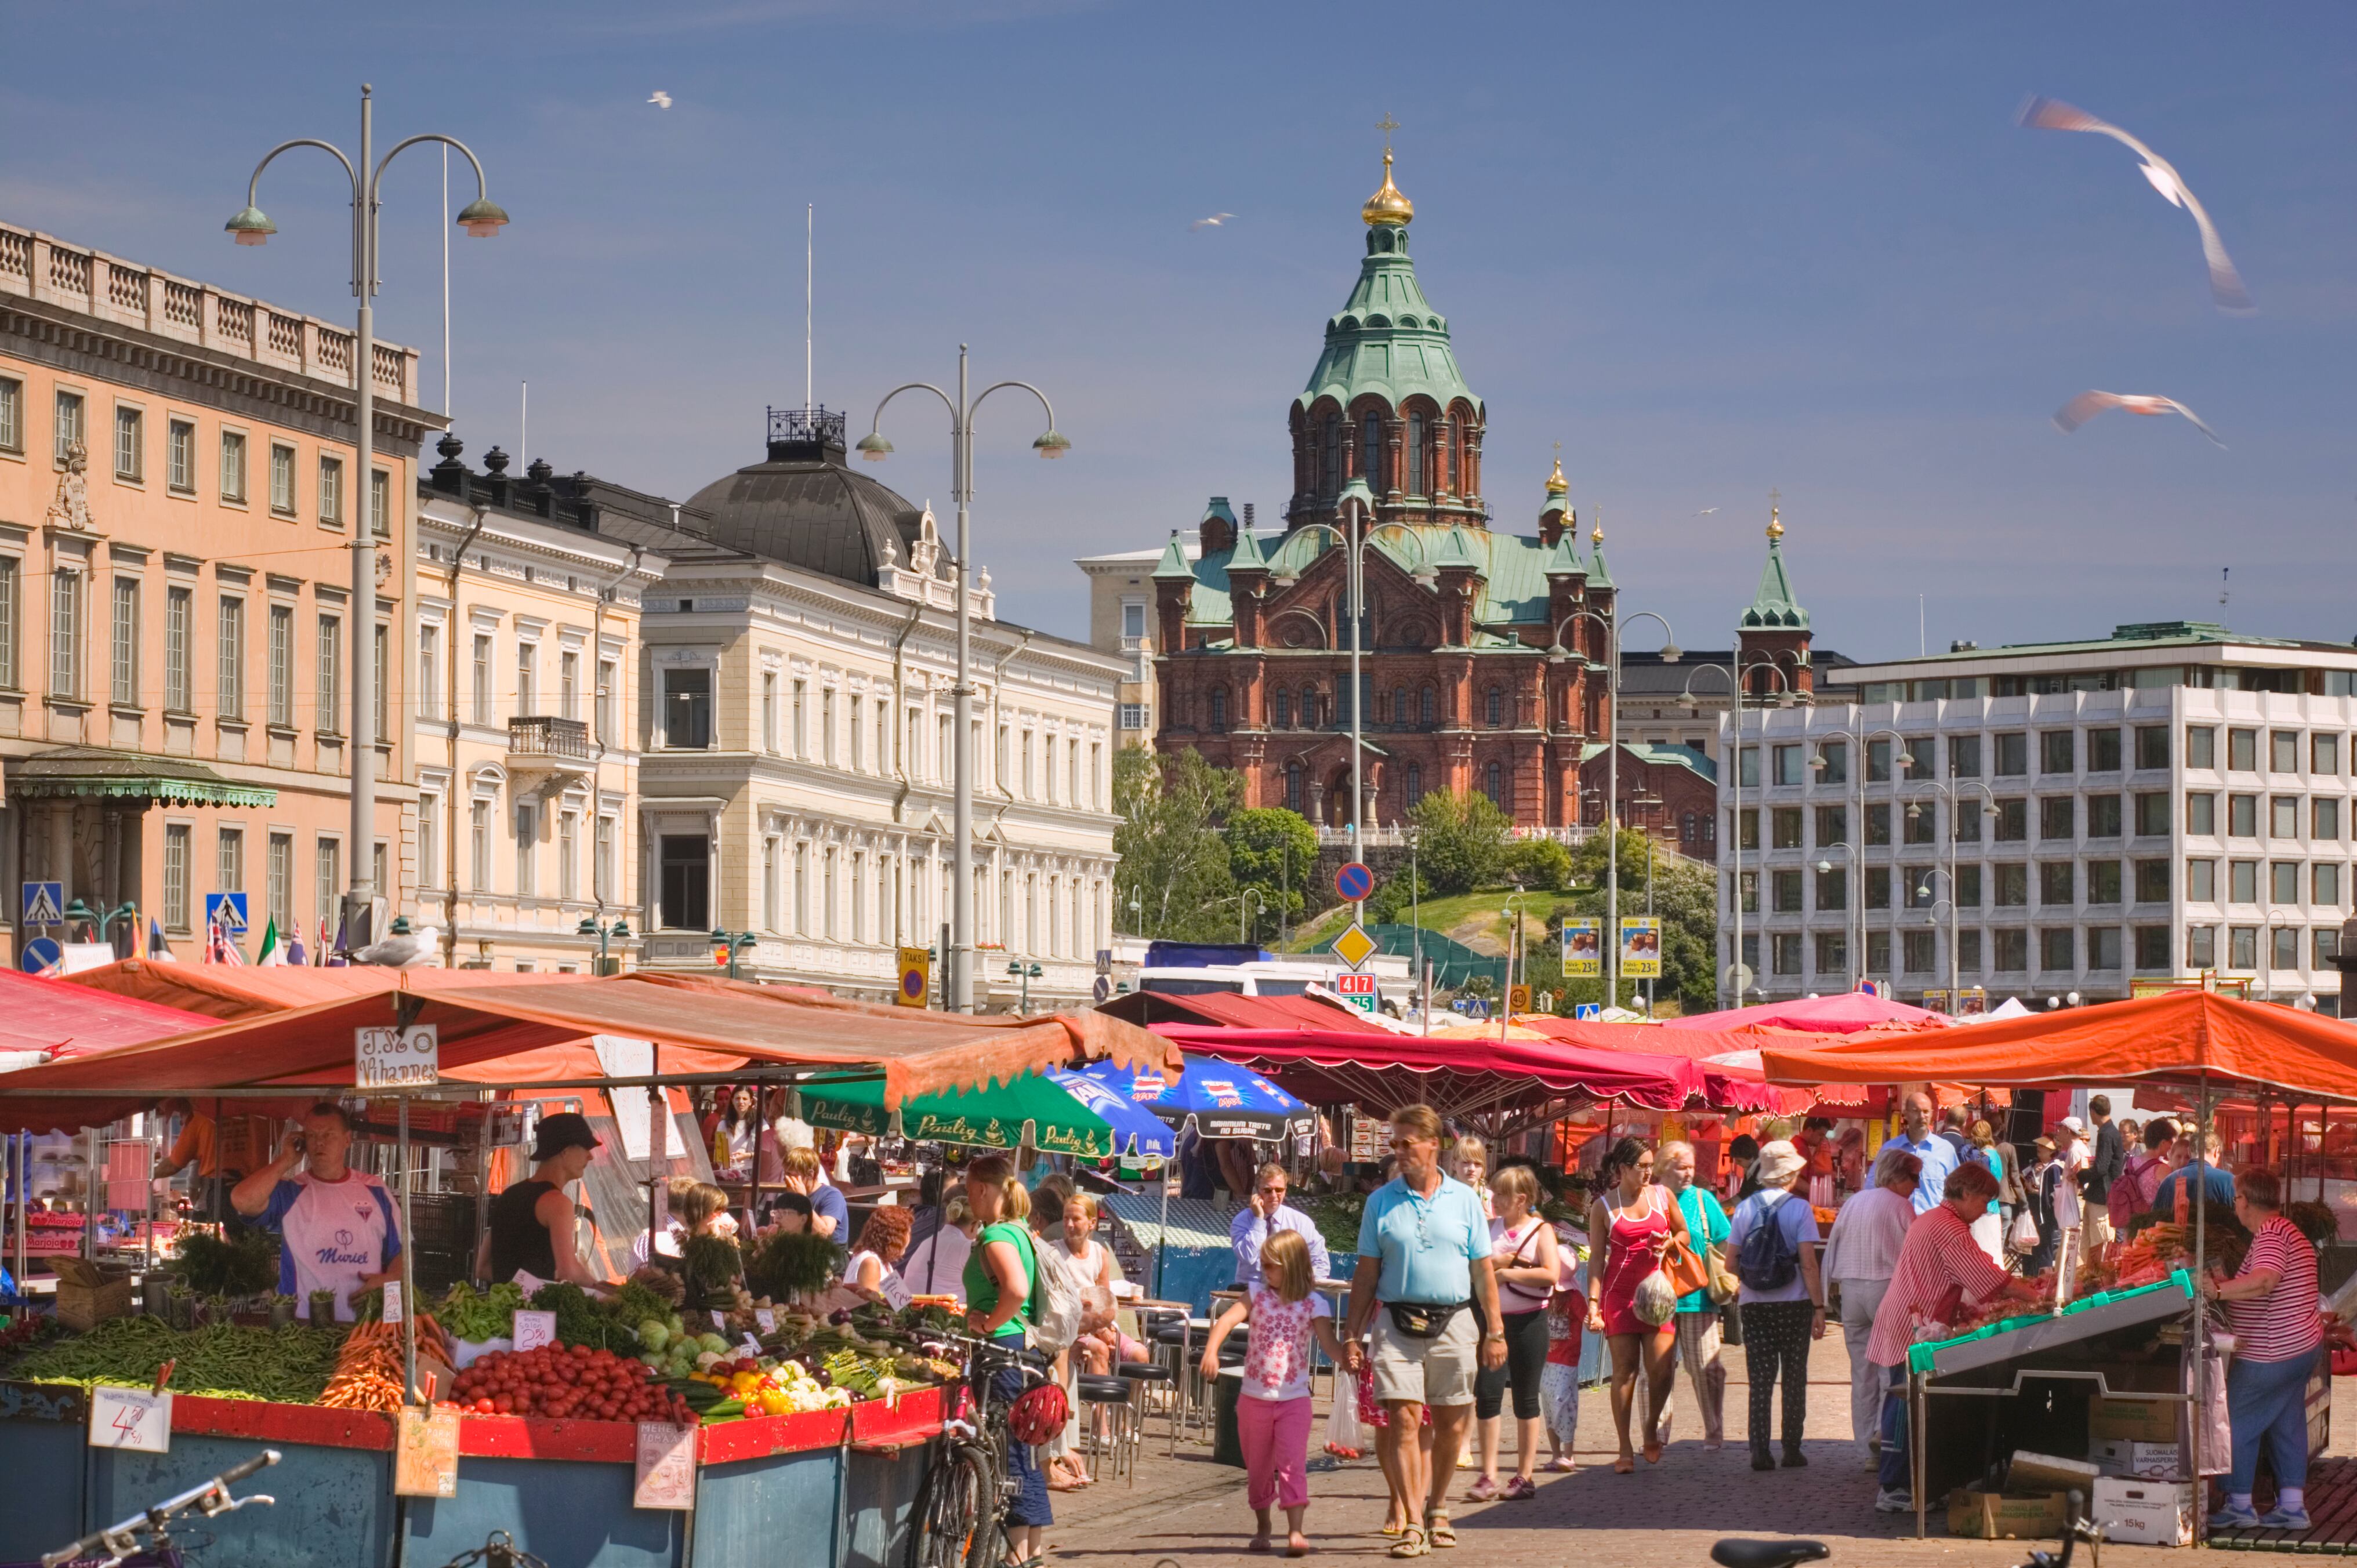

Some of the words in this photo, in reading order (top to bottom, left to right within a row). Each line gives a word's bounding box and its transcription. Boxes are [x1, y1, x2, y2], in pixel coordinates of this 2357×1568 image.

[905, 953, 925, 964] TAKSI
[1582, 962, 1592, 973] 23
[1641, 963, 1651, 973] 23
[1343, 977, 1352, 992] 4
[1361, 977, 1369, 992] 7
[1513, 993, 1524, 1003] 40
[359, 1057, 436, 1086] Vihannes
[1219, 1097, 1243, 1108] MAX
[810, 1101, 856, 1128] Paulig
[918, 1115, 977, 1141] Paulig
[1248, 1121, 1271, 1130] TASTE
[1045, 1126, 1081, 1151] Paulig
[48, 1217, 81, 1225] Marjoja
[27, 1238, 59, 1247] Marjoja
[316, 1247, 368, 1264] Muriel
